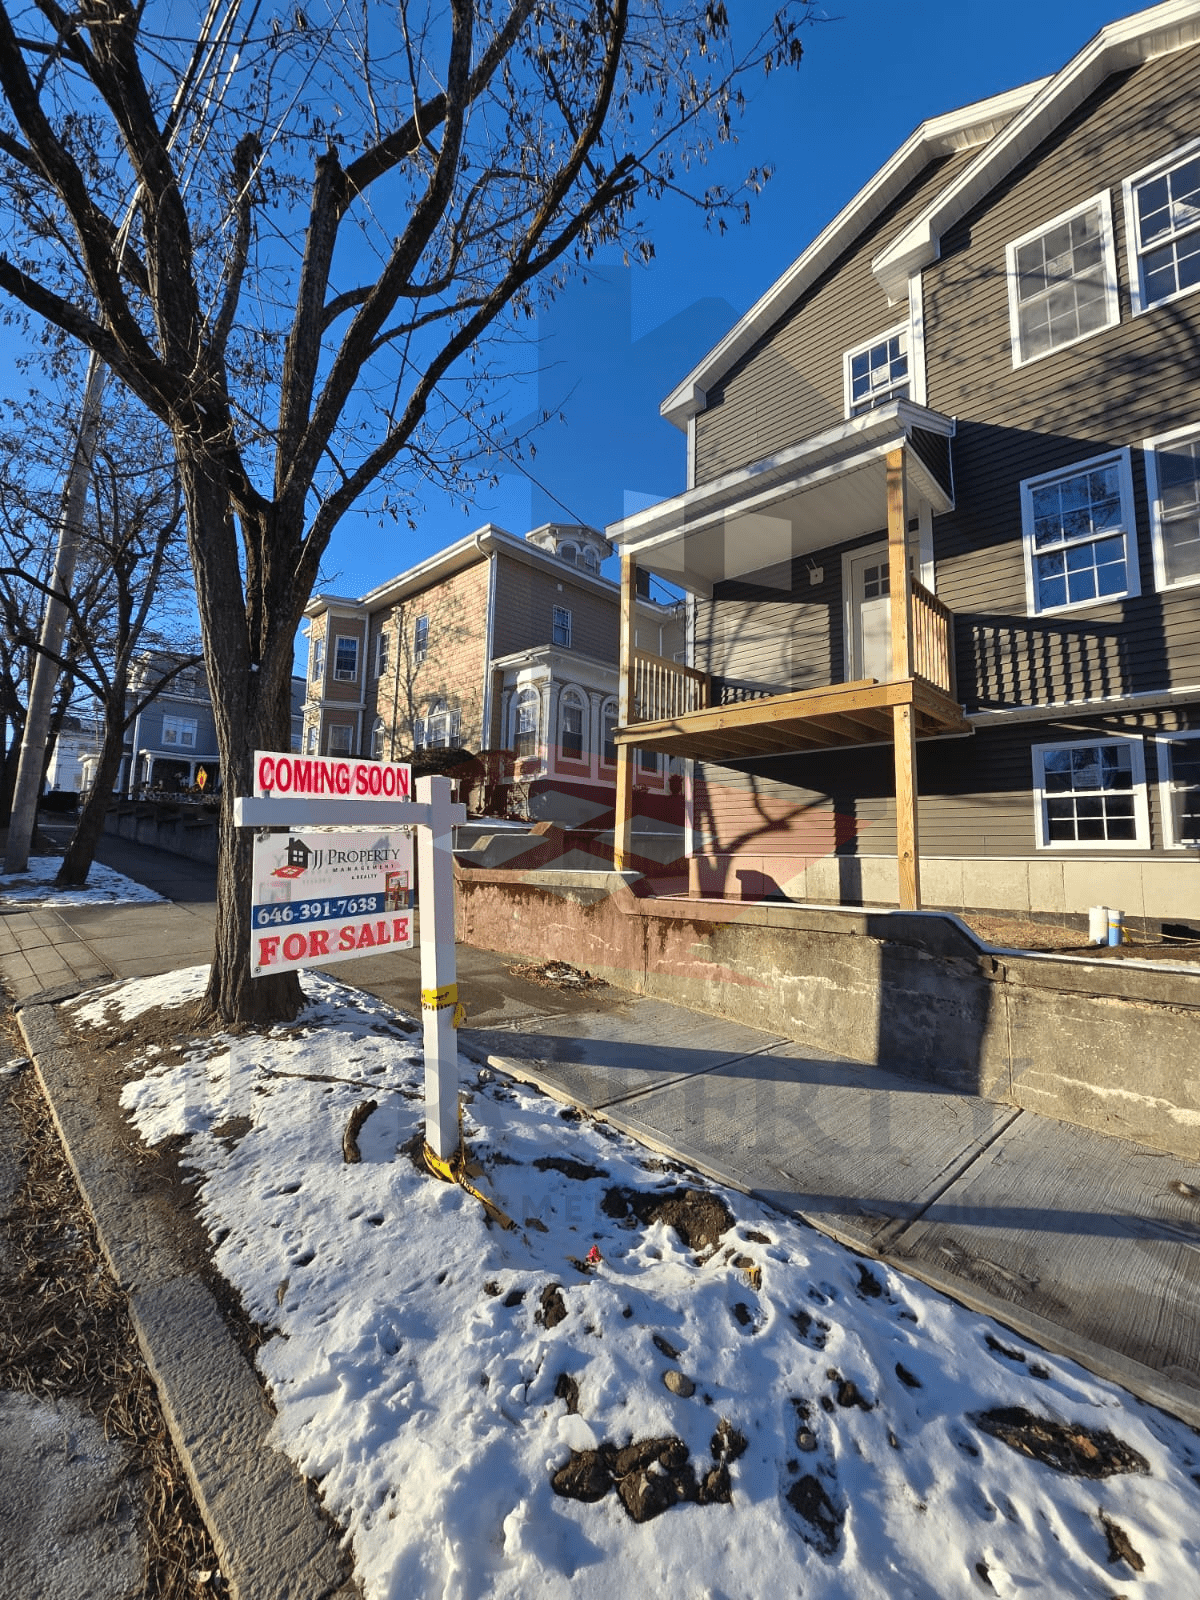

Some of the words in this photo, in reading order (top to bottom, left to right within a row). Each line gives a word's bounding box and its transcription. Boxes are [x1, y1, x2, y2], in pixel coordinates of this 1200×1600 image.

[258, 756, 350, 795] COMING
[355, 764, 409, 797] SOON
[312, 849, 323, 871] JJ
[328, 848, 400, 865] PROPERTY
[332, 863, 394, 873] MANAGEMENT
[257, 896, 377, 925] 646-391-7638
[258, 930, 330, 966] FOR
[338, 917, 409, 951] SALE
